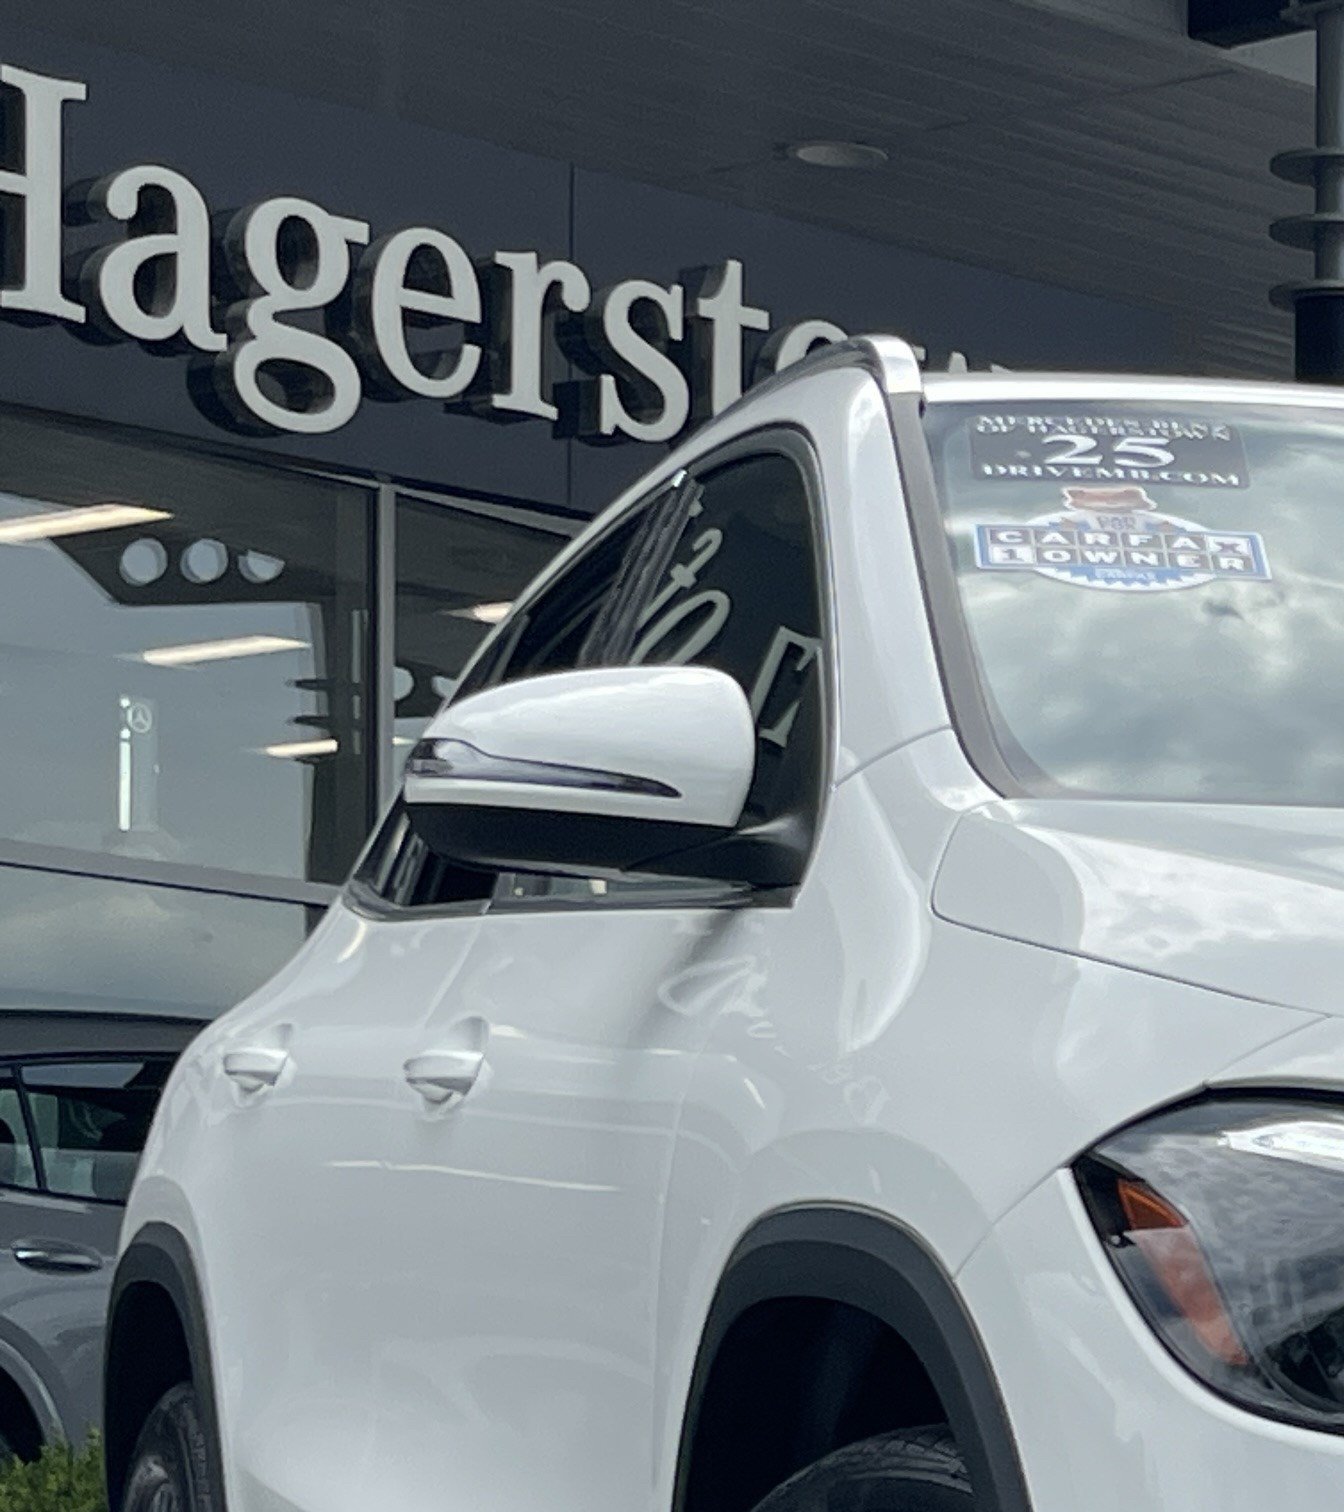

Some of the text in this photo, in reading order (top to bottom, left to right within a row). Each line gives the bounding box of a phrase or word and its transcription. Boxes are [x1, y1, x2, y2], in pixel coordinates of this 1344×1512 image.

[1042, 434, 1175, 468] 25
[999, 531, 1242, 553] CARFAX
[1044, 550, 1244, 571] OWNER
